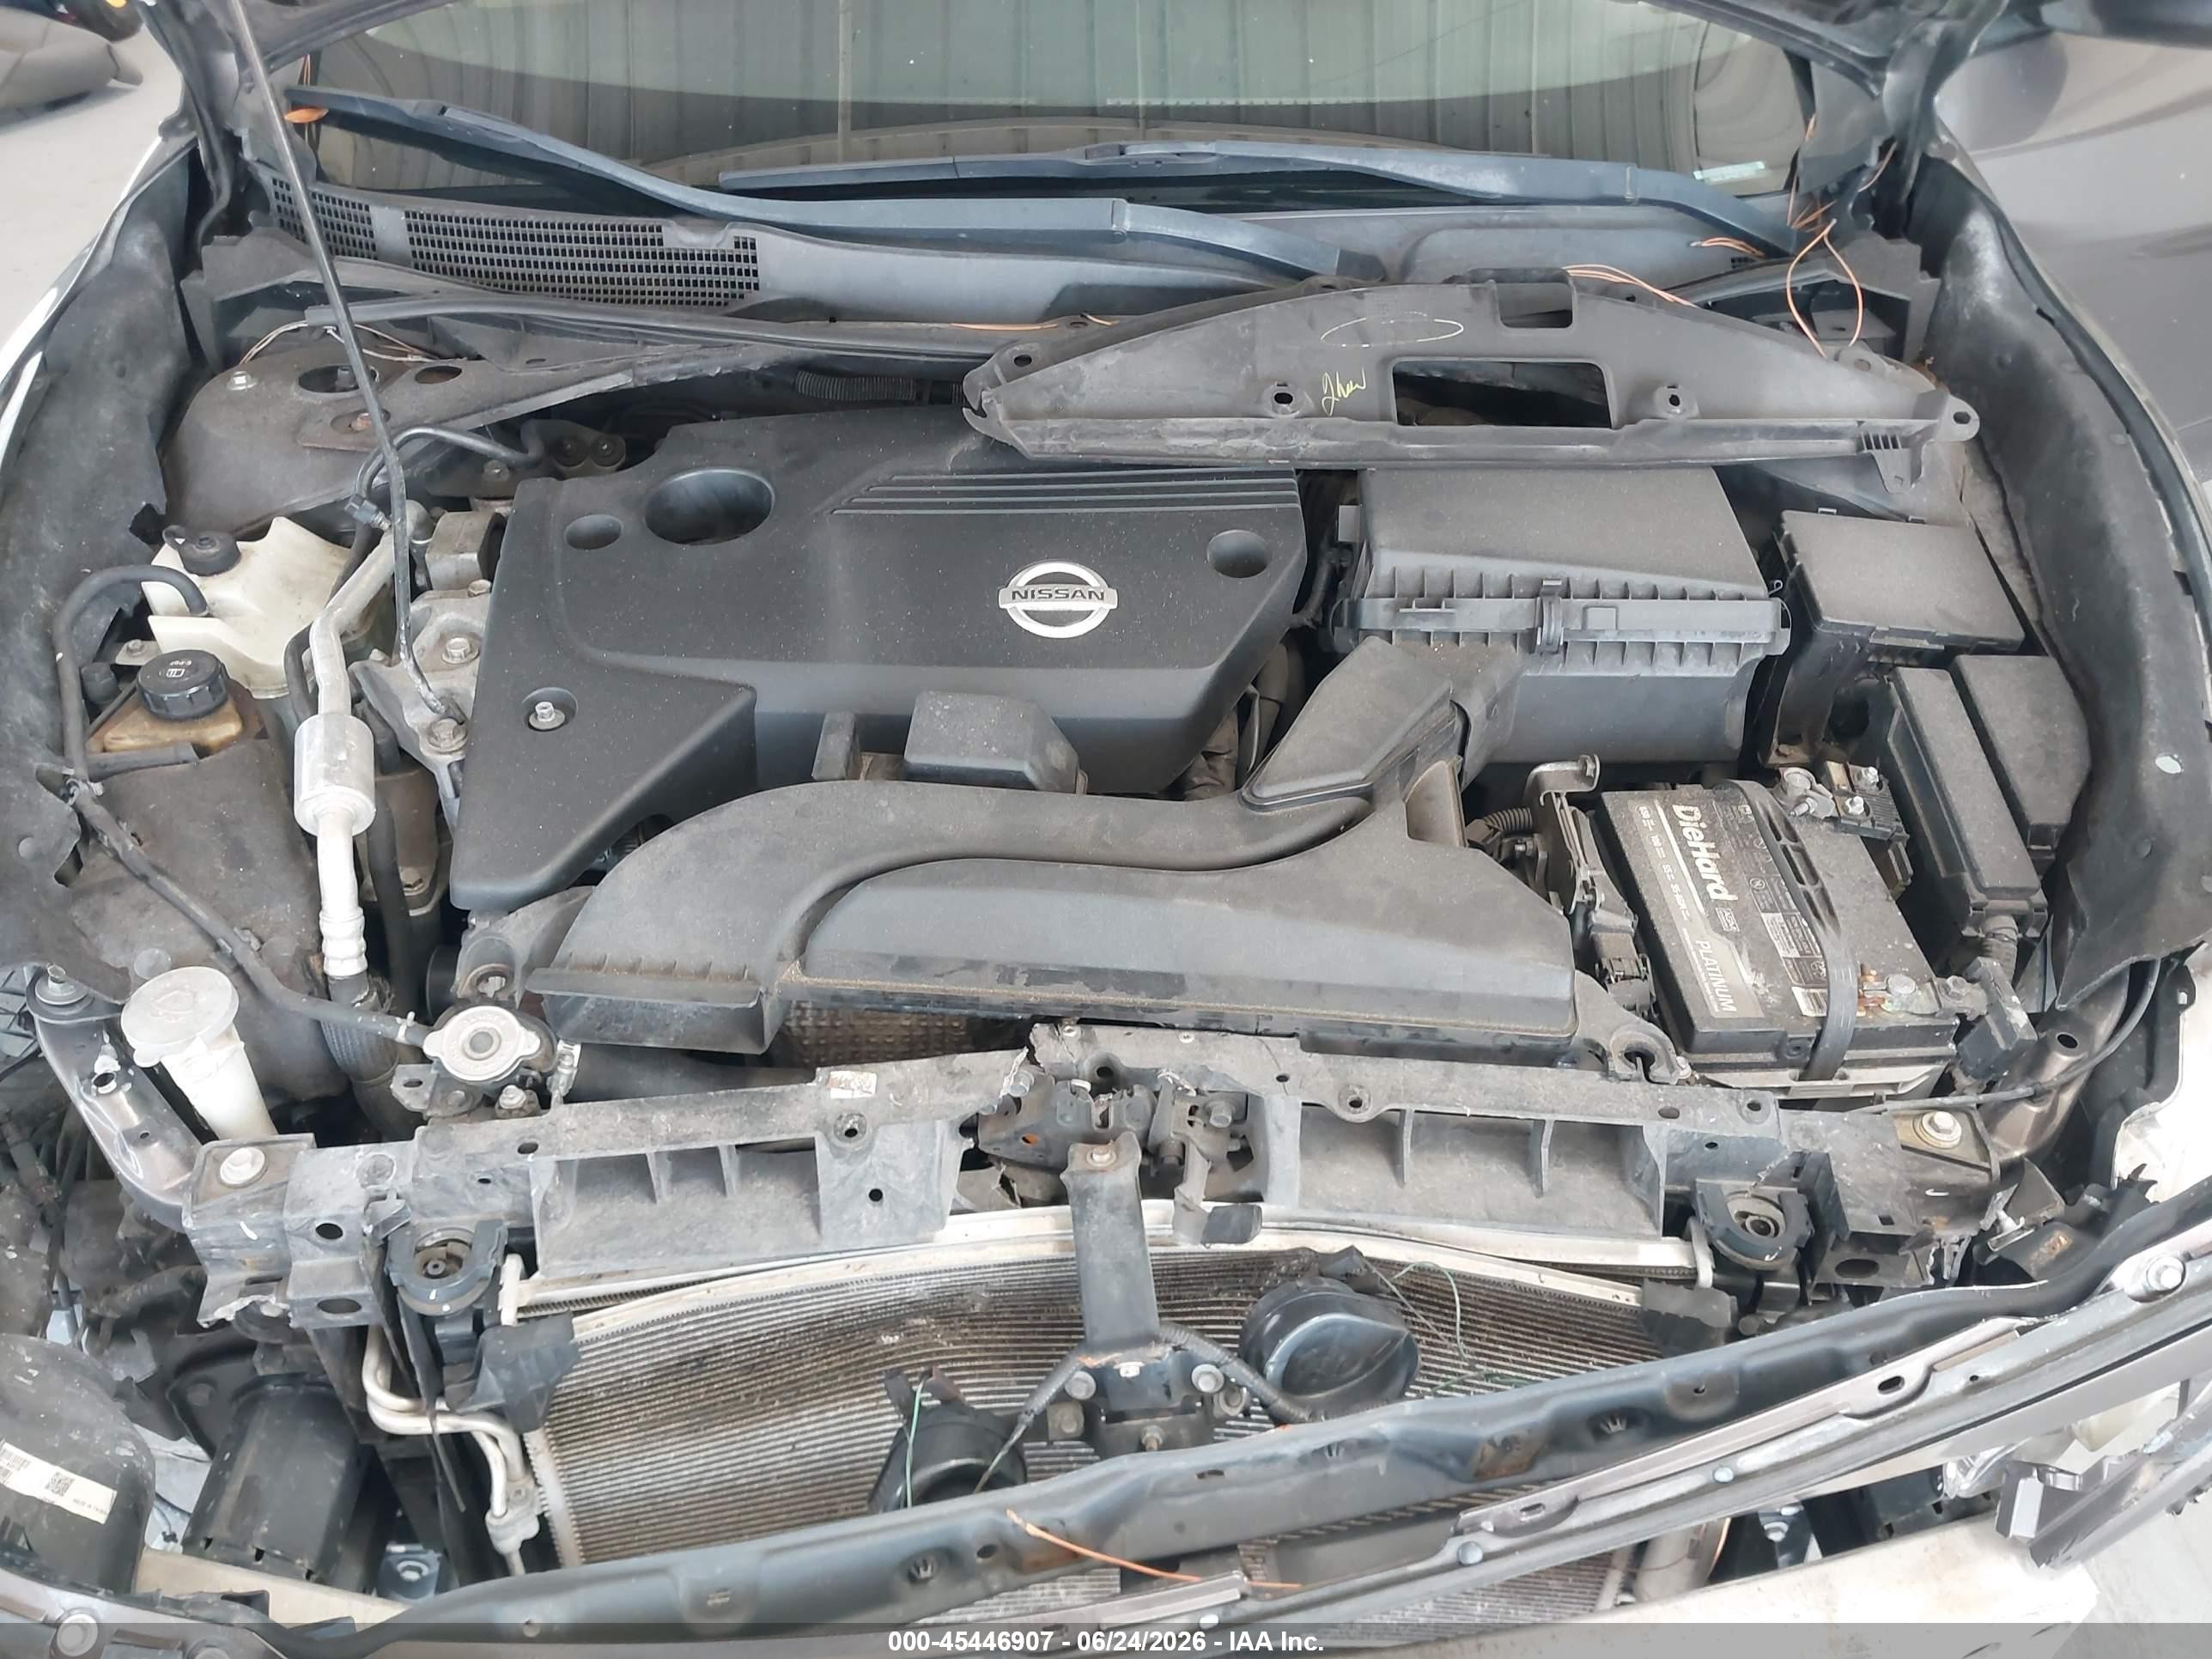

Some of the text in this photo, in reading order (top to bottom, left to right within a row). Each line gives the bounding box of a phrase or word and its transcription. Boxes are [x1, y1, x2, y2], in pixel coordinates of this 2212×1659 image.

[1012, 588, 1105, 601] NISSAN
[1672, 804, 1738, 901] DieHard
[1695, 939, 1738, 1012] PLATINUM
